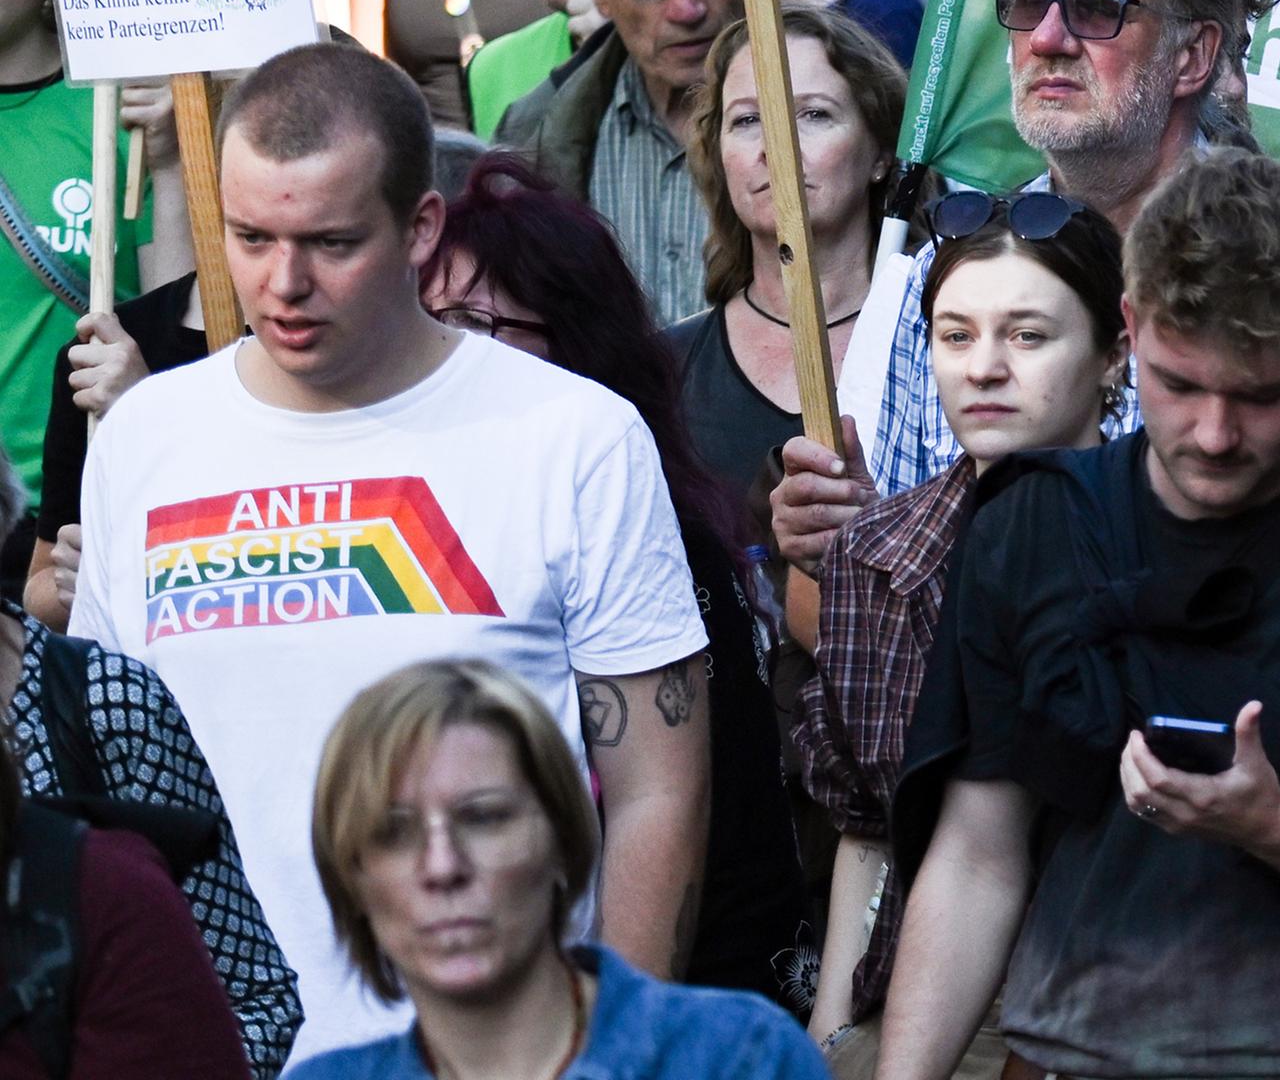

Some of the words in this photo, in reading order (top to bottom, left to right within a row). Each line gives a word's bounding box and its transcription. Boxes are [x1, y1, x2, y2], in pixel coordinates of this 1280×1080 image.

[66, 21, 105, 40] keine
[109, 12, 225, 41] Parteigrenzen!
[920, 88, 936, 118] auf
[227, 483, 352, 532] ANTI
[147, 529, 364, 595] FASCIST
[152, 576, 349, 639] ACTION
